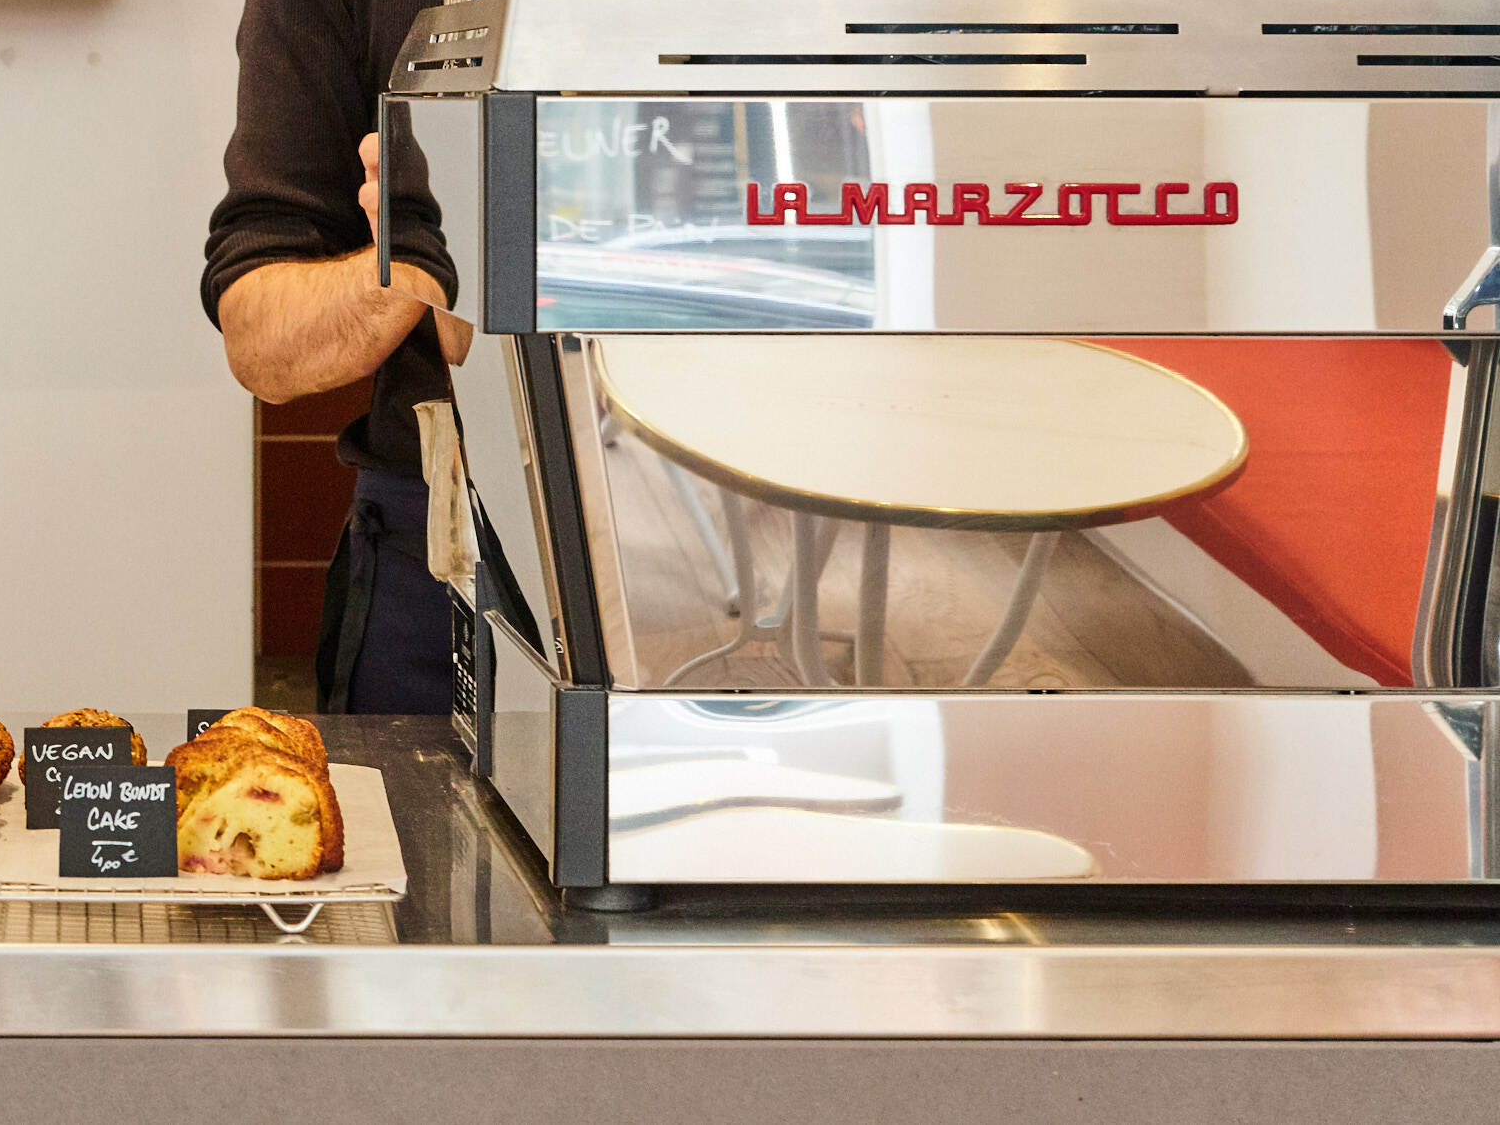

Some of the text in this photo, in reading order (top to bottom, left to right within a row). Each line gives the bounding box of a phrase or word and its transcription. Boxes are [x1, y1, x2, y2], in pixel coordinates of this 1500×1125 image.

[747, 182, 1239, 226] LA MARZOCCO
[32, 743, 113, 762] VEGAN
[87, 807, 140, 831] CAKE
